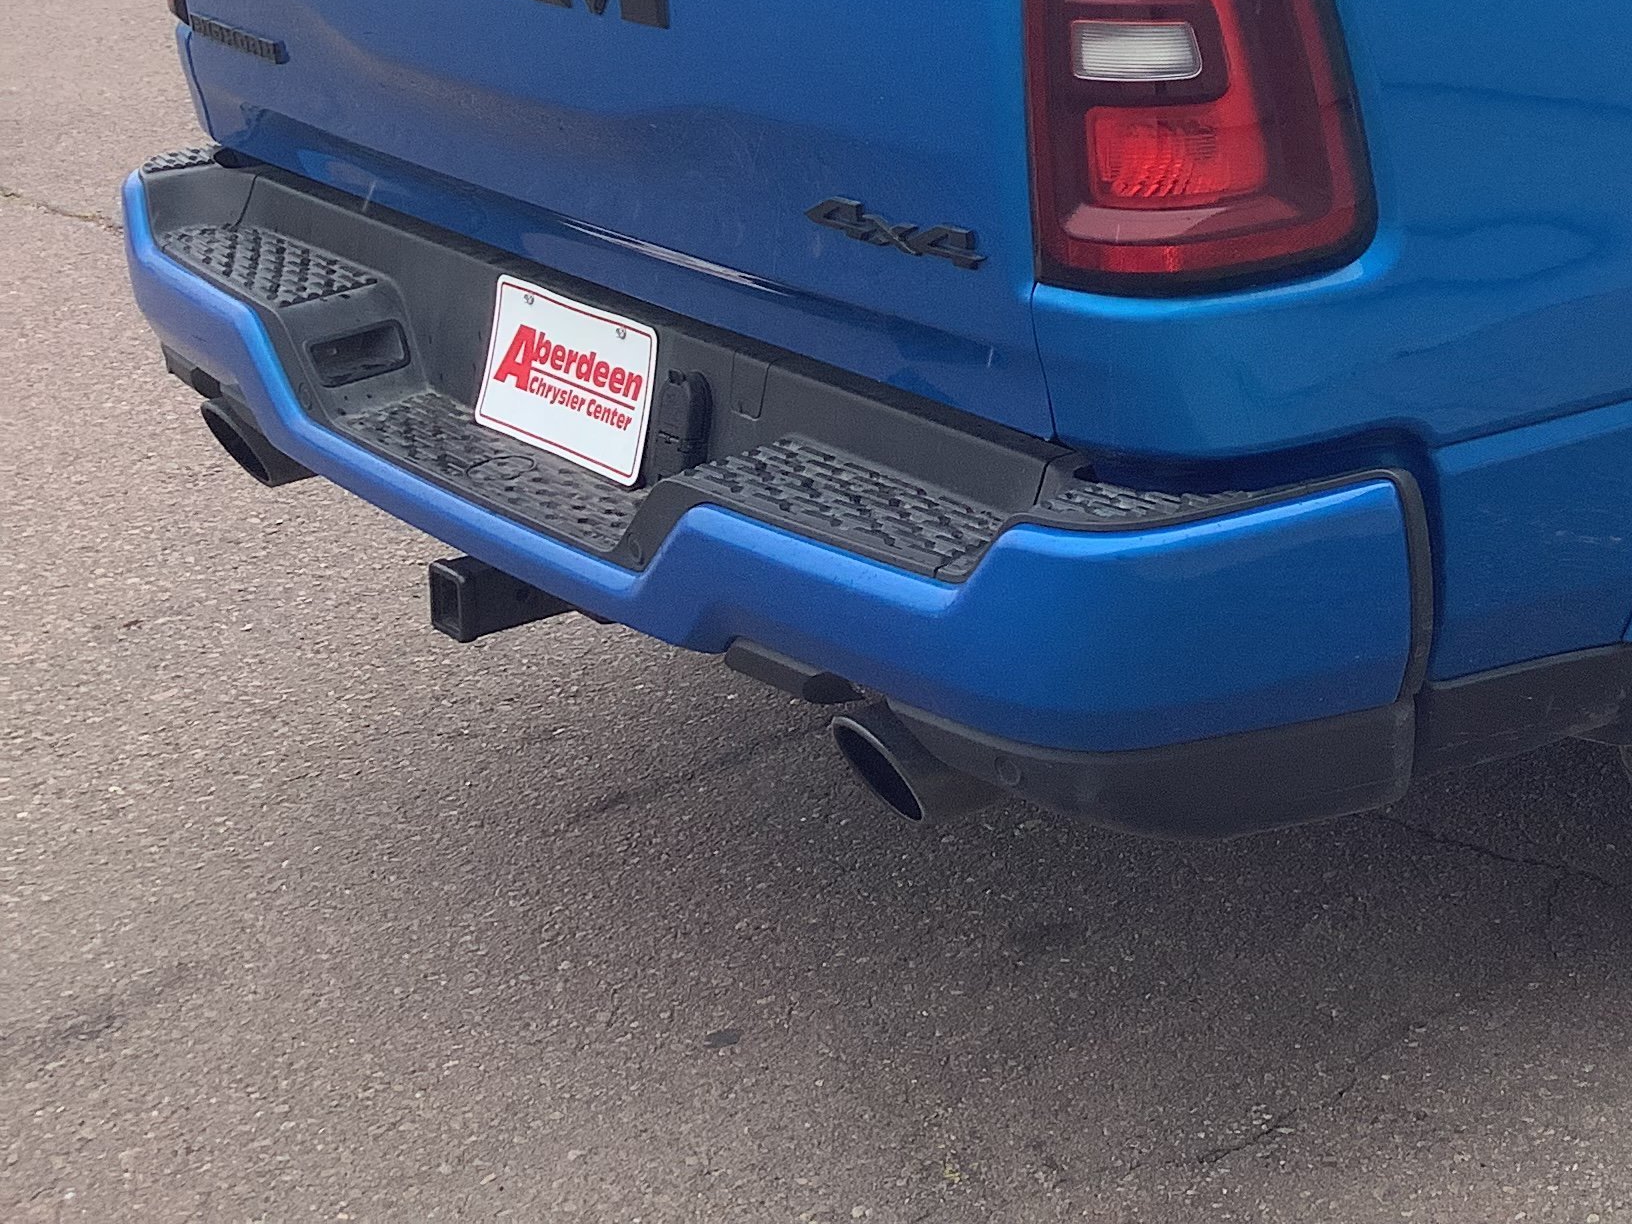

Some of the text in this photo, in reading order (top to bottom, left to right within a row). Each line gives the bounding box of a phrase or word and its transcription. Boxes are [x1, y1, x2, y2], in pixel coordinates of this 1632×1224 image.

[803, 195, 988, 271] 4x4
[493, 323, 643, 402] Aberdeen
[528, 375, 633, 432] Chrysler Center
